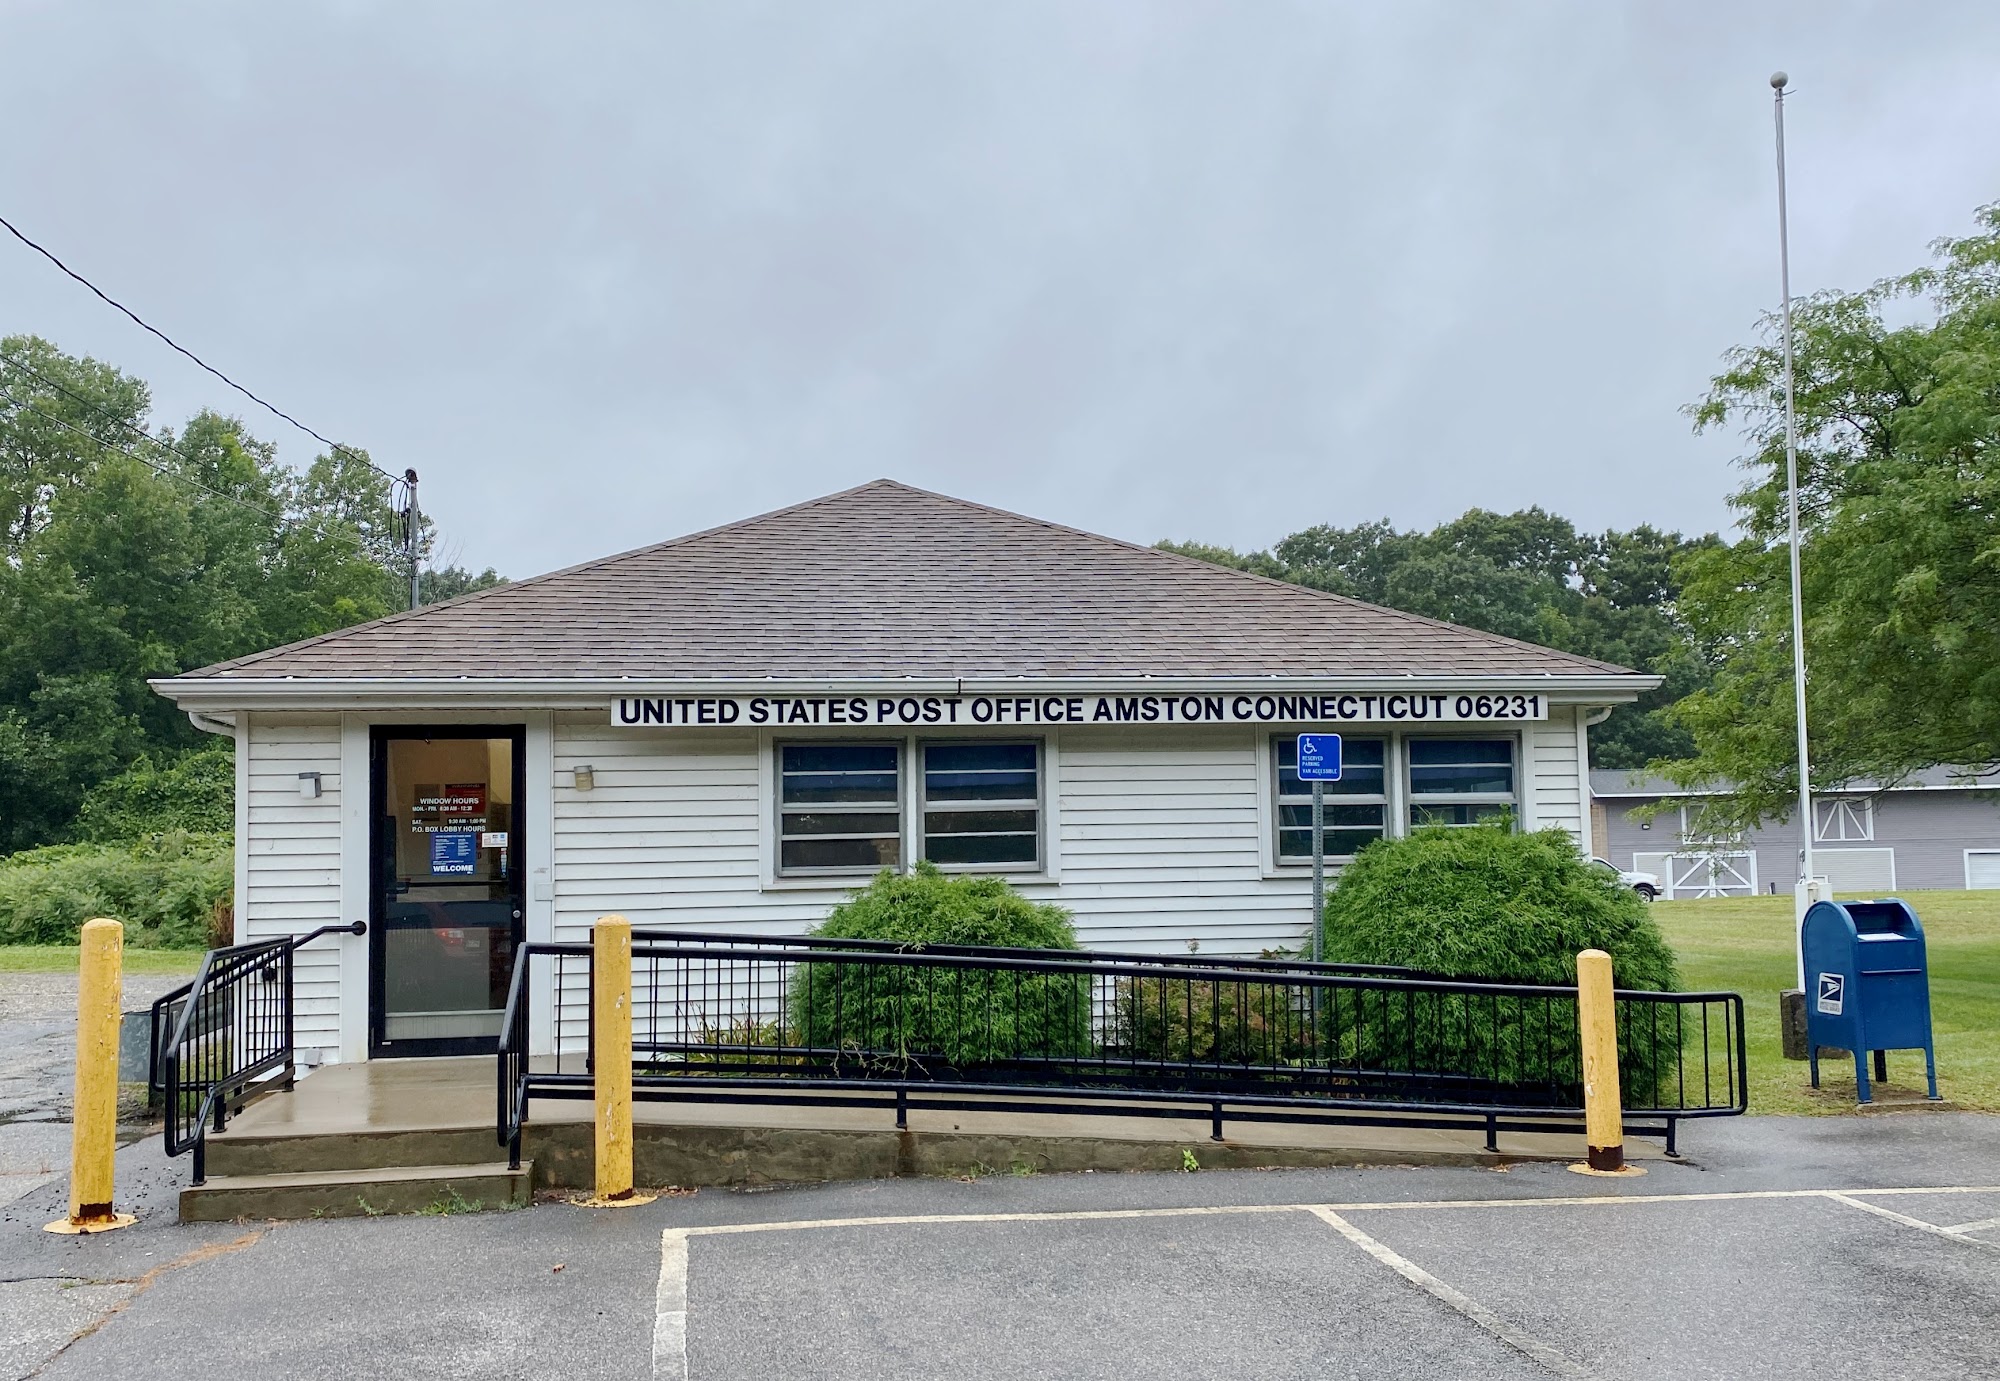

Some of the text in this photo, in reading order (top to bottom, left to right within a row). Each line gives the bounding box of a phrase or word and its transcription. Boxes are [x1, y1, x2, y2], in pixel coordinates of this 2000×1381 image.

[620, 695, 1539, 724] UNITED STATES POST OFFICE AMSTON CONNECTICUT 06231
